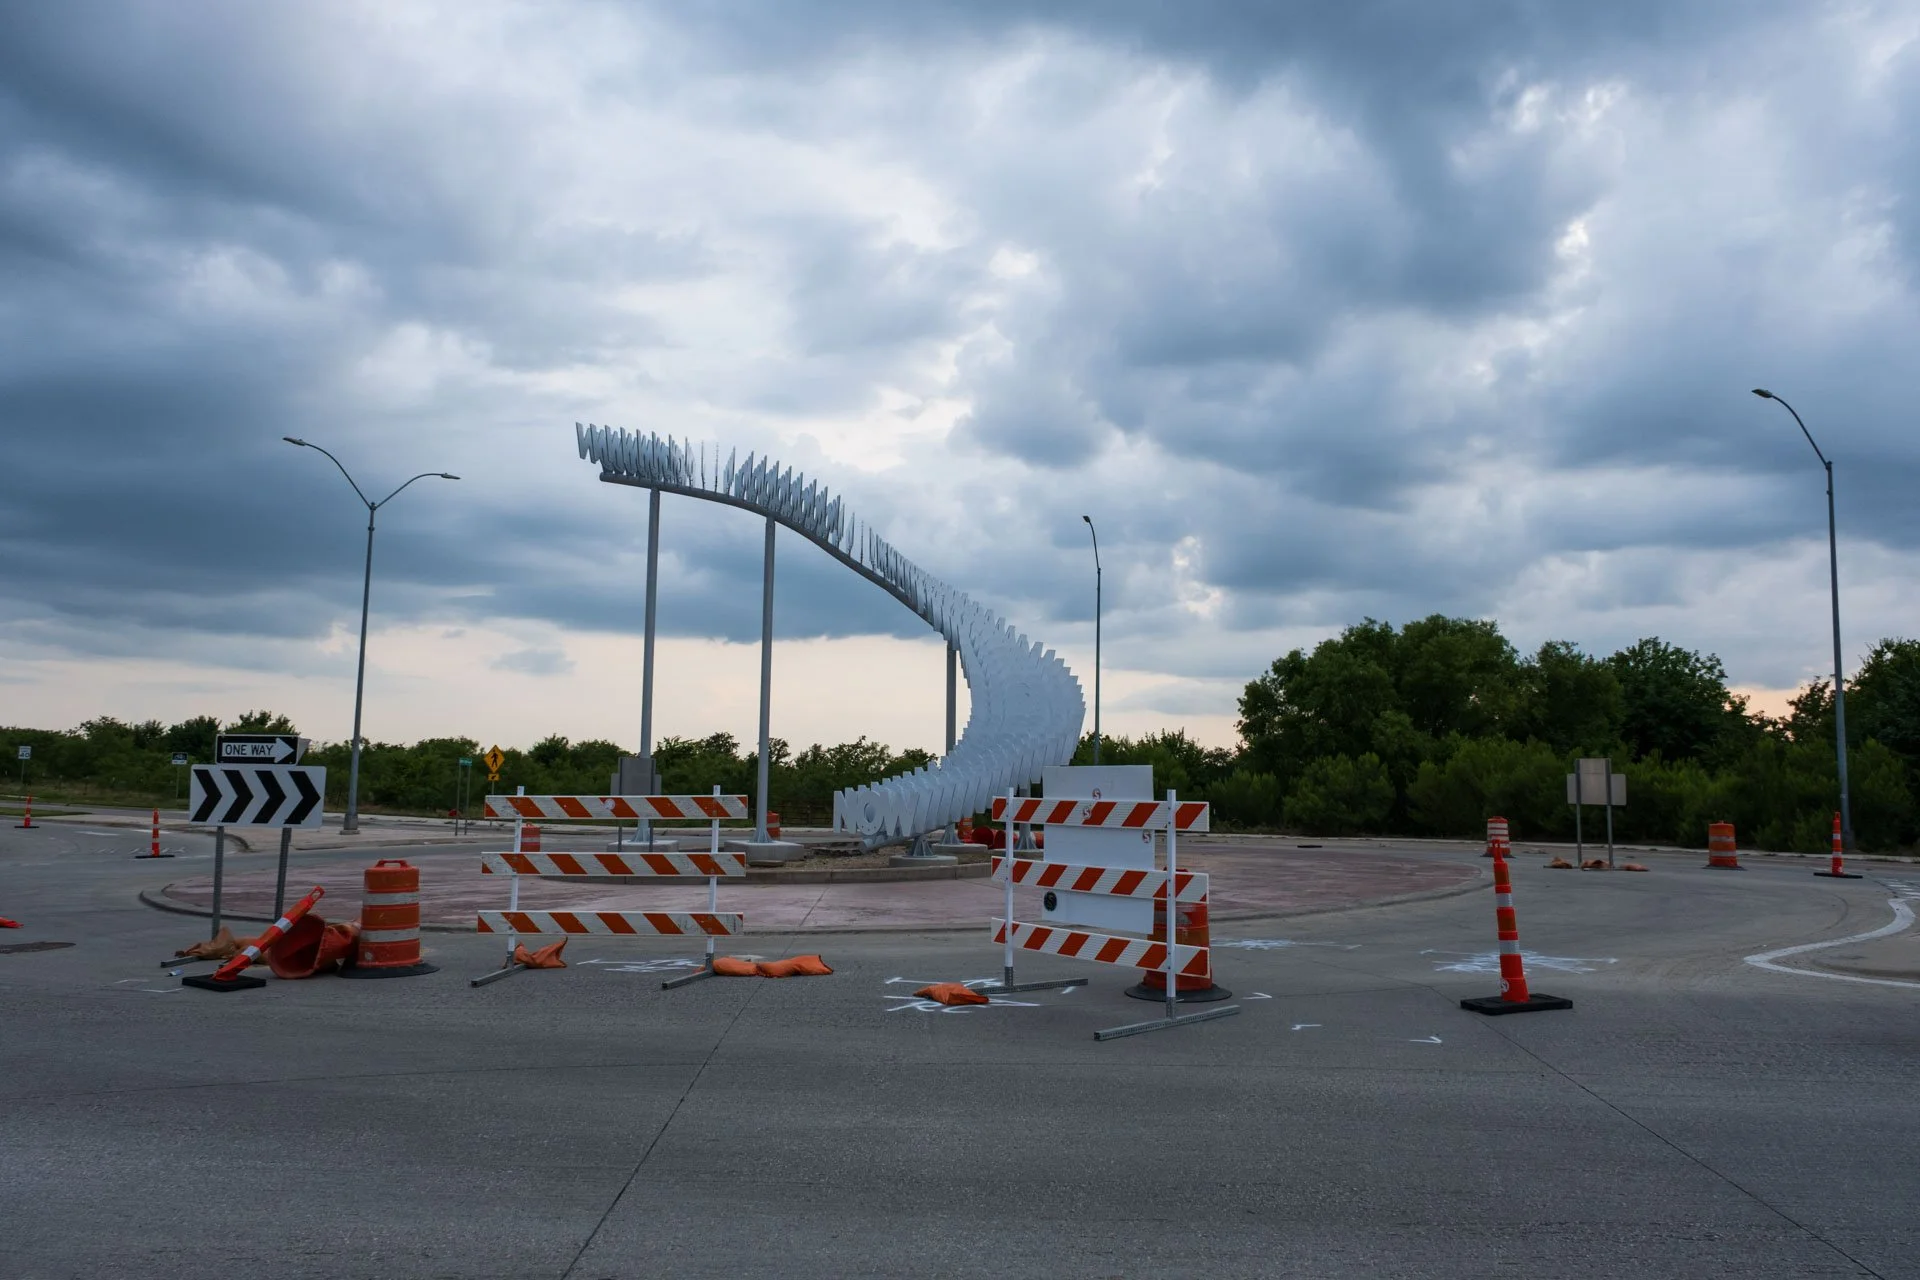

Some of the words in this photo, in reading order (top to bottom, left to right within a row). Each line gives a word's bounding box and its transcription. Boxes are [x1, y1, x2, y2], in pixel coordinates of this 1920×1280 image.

[225, 744, 247, 756] ONE
[251, 744, 273, 756] WAY
[833, 790, 920, 836] NOW
